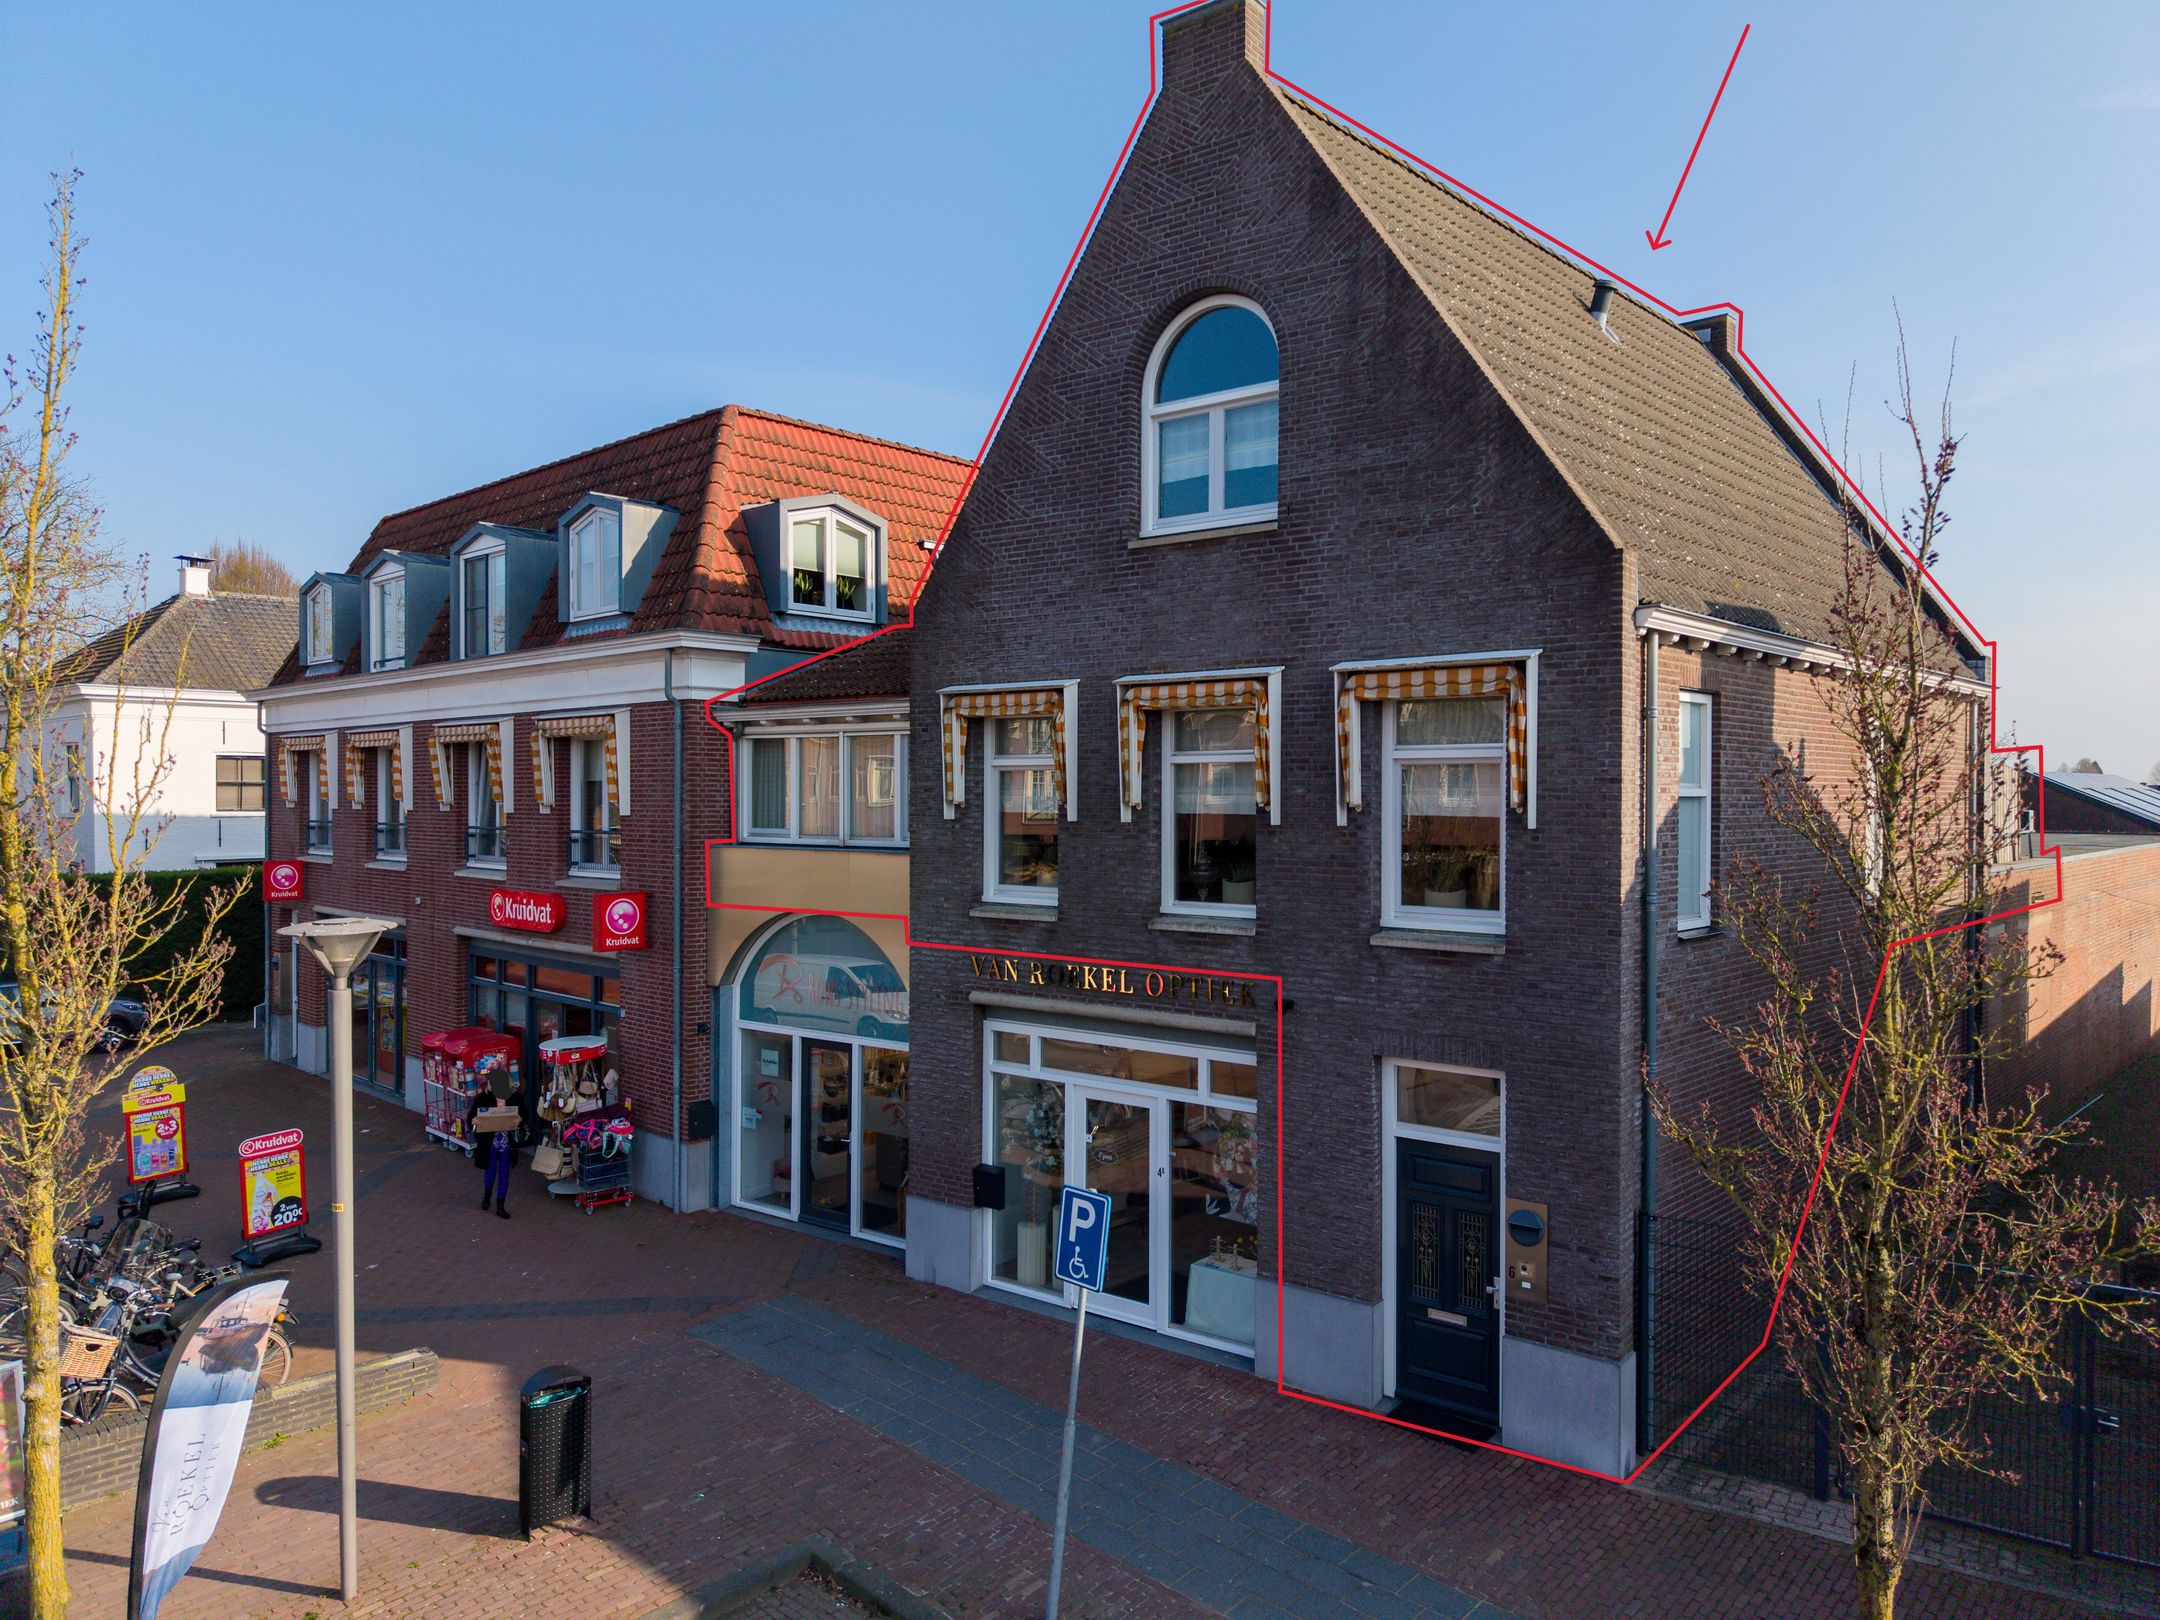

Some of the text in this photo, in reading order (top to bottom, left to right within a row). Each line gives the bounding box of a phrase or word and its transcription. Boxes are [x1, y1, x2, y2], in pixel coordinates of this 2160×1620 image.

[271, 890, 298, 898] Kruidvat
[505, 896, 552, 924] Kruidvat
[606, 936, 639, 947] Kruidvat
[970, 955, 1258, 1008] VAN ROEKEL OPTIEK
[145, 1095, 170, 1104] Kruidvat
[158, 1120, 177, 1133] 2+3
[255, 1133, 298, 1150] Kruidvat
[280, 1204, 286, 1212] 2
[1069, 1197, 1096, 1242] P
[1509, 1266, 1515, 1279] 6
[170, 1433, 205, 1535] ROEKEL
